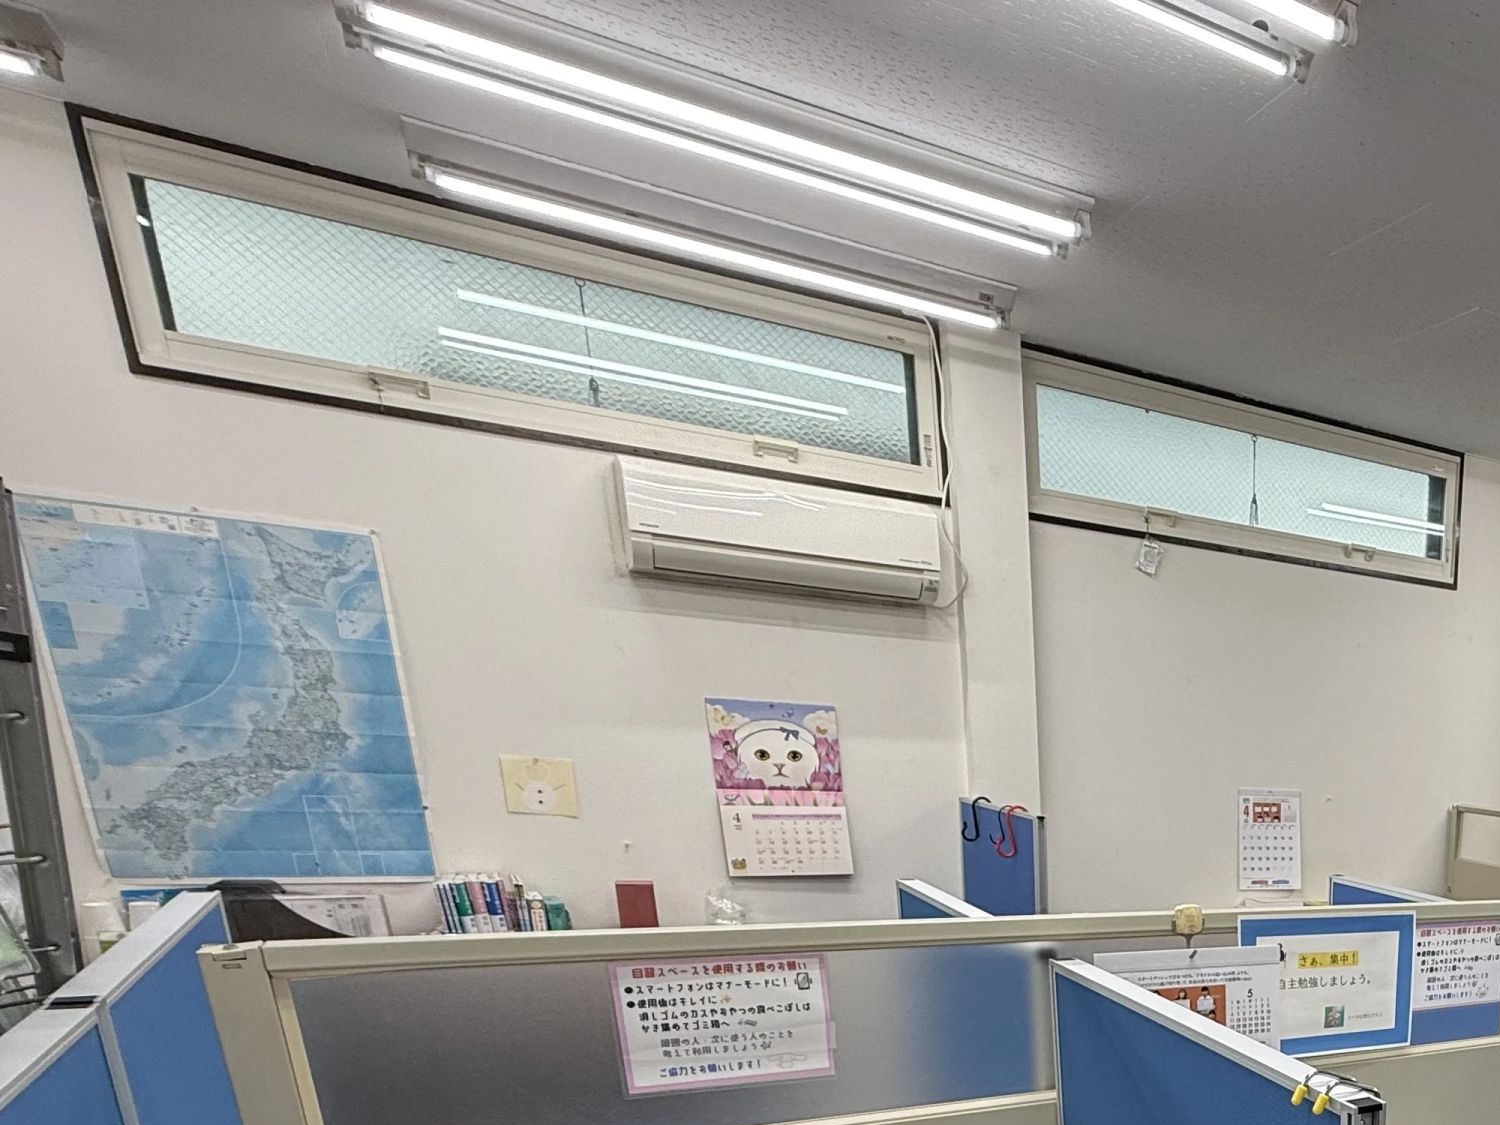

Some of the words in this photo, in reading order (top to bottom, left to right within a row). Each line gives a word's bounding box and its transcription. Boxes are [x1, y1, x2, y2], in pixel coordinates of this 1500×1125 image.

[1243, 805, 1249, 817] 4
[732, 813, 741, 823] 4
[632, 960, 807, 979] 自習スペースを使用する際のお願い
[1247, 988, 1253, 998] 5
